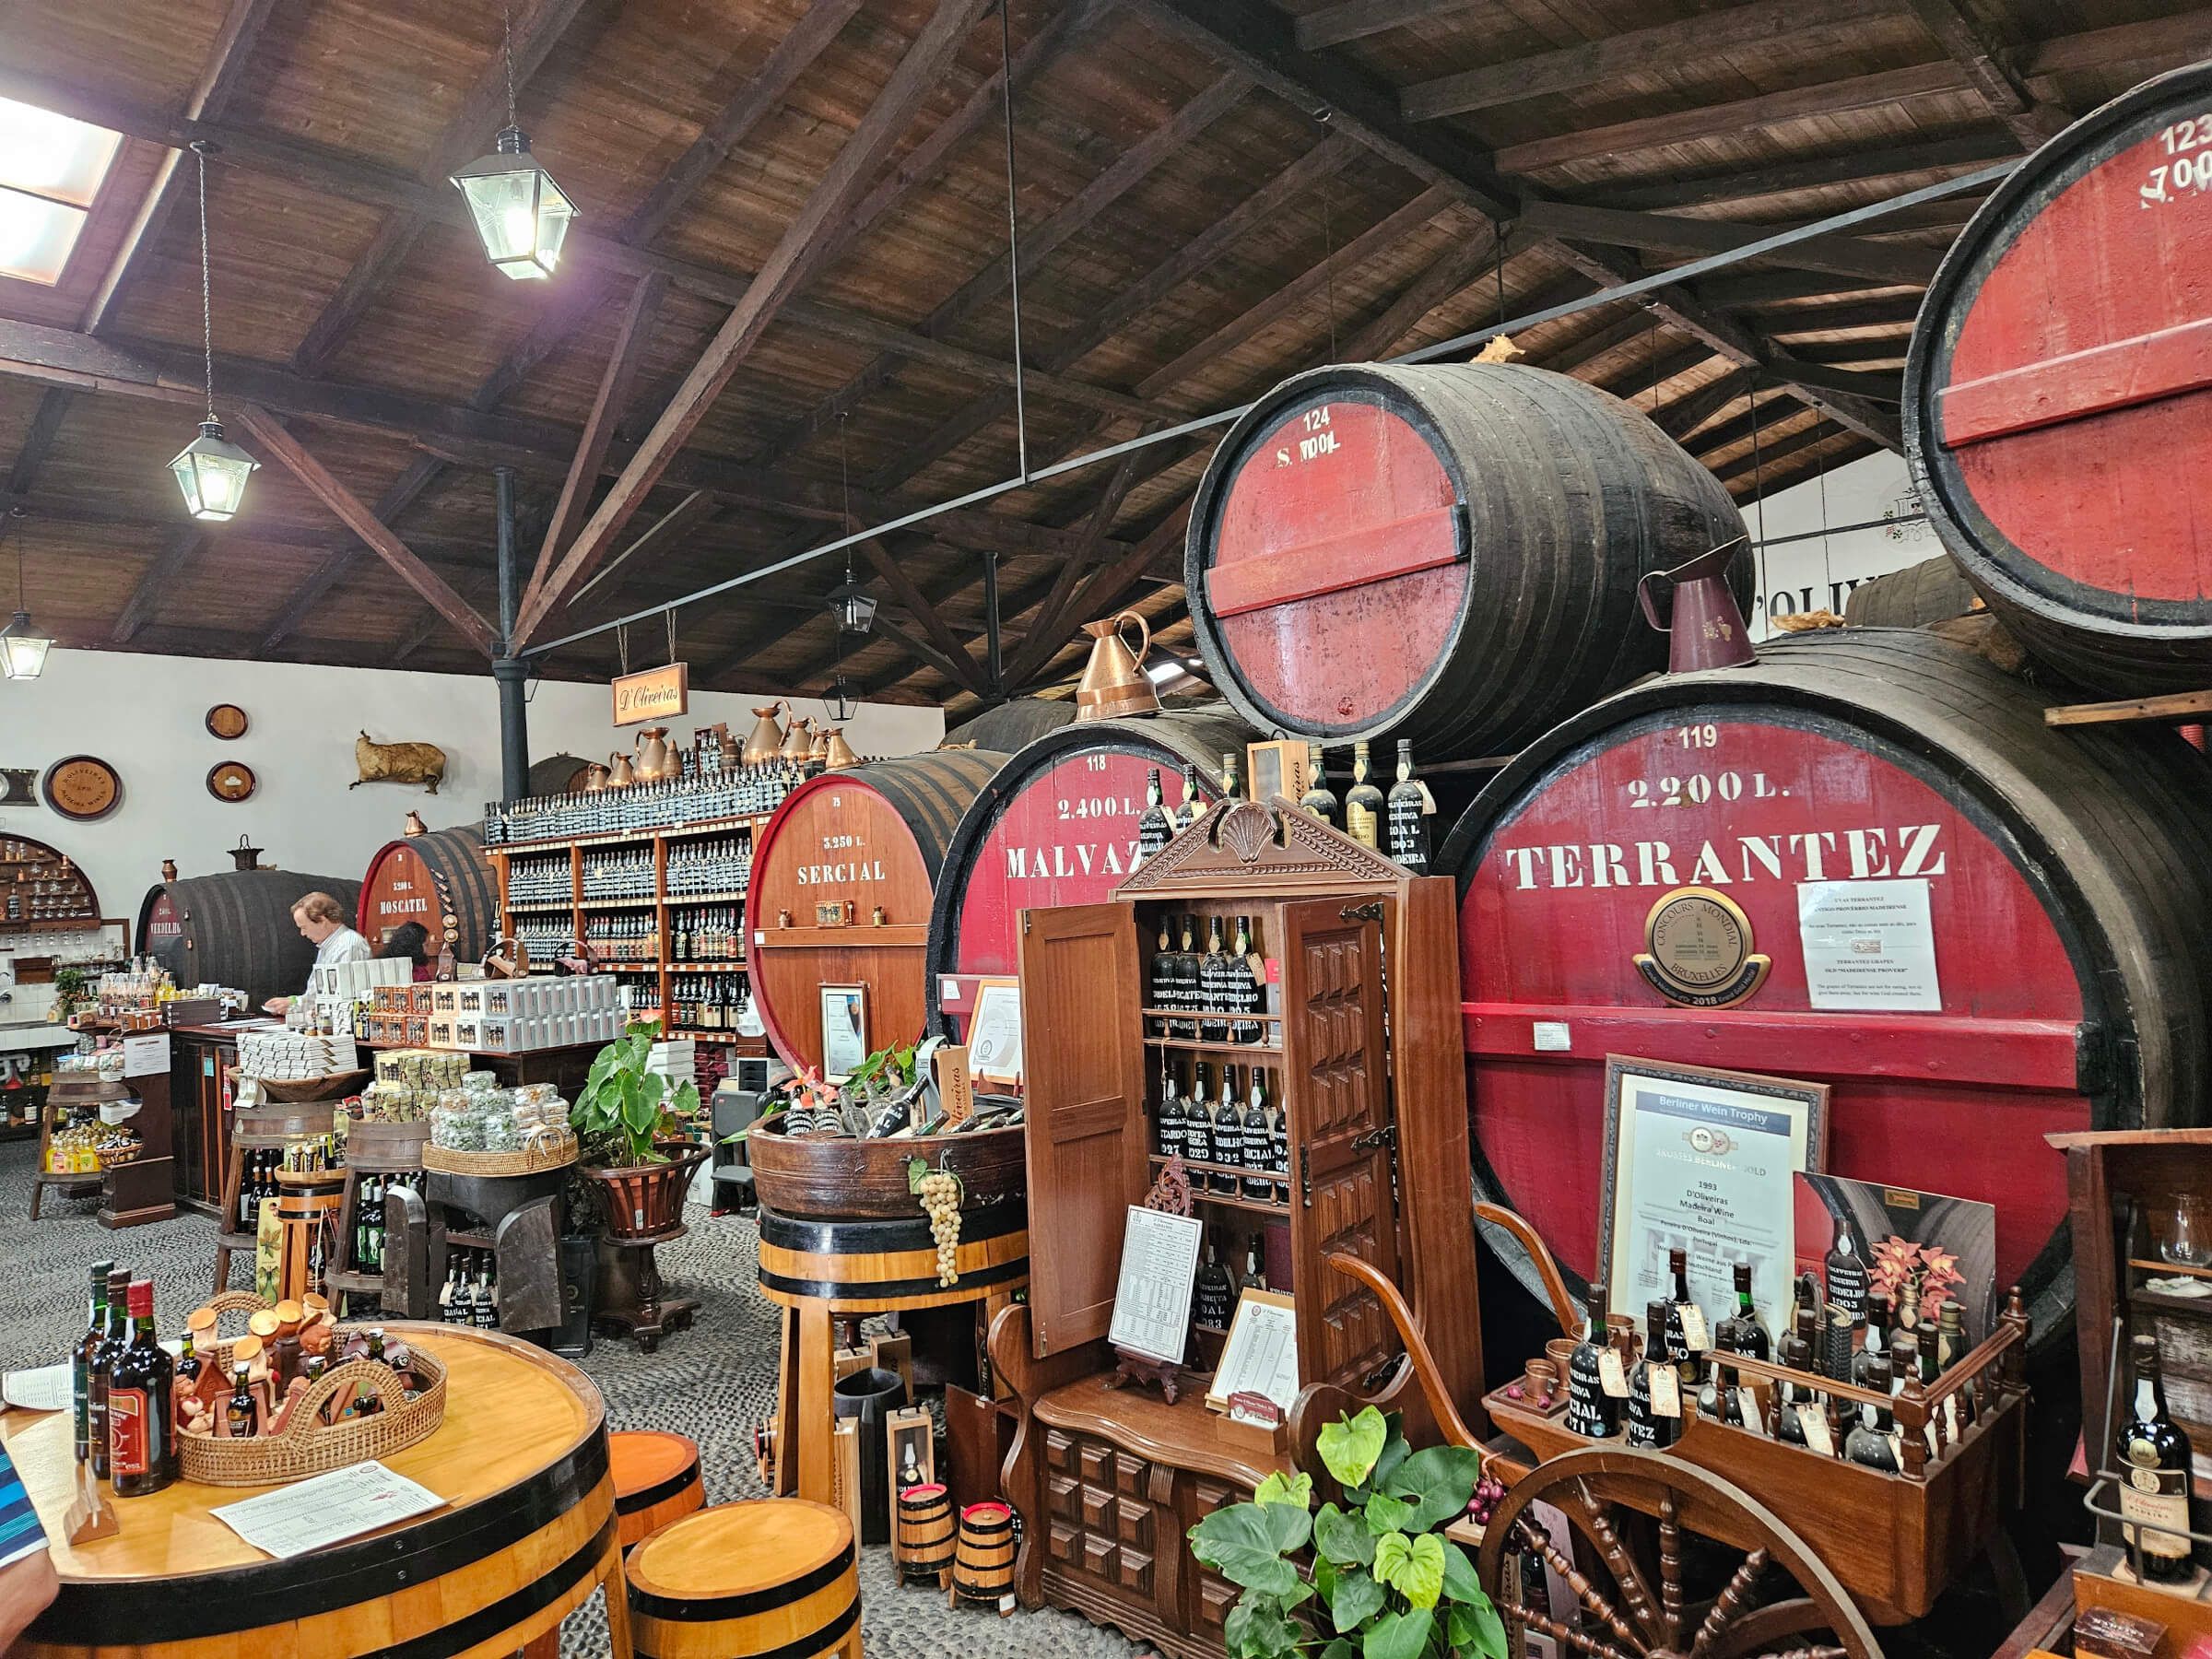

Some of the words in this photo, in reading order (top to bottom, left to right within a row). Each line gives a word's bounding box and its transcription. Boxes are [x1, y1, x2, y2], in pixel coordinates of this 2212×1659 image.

[1303, 406, 1330, 431] 124
[619, 685, 678, 712] D'Oliveiras
[1678, 724, 1717, 749] 119
[1087, 755, 1106, 771] 118
[1506, 824, 1946, 890] TERRANTEZ
[797, 861, 886, 885] SERCIAL
[380, 898, 428, 914] MOSCATEL
[1656, 901, 1694, 946] CONCOURS
[1700, 903, 1738, 946] MONDIAL
[1670, 962, 1728, 982] BRUXELLES
[1692, 995, 1718, 1006] 2018
[1659, 1095, 1699, 1112] Berliner
[1701, 1102, 1728, 1116] Wein
[1729, 1108, 1769, 1124] Trophy
[1698, 1181, 1717, 1191] 1993
[1687, 1189, 1728, 1206] D'Oliveiras
[1679, 1199, 1712, 1214] Madeira
[1713, 1206, 1735, 1218] Wine
[1698, 1215, 1715, 1226] Boal
[1693, 1236, 1718, 1247] Portugal
